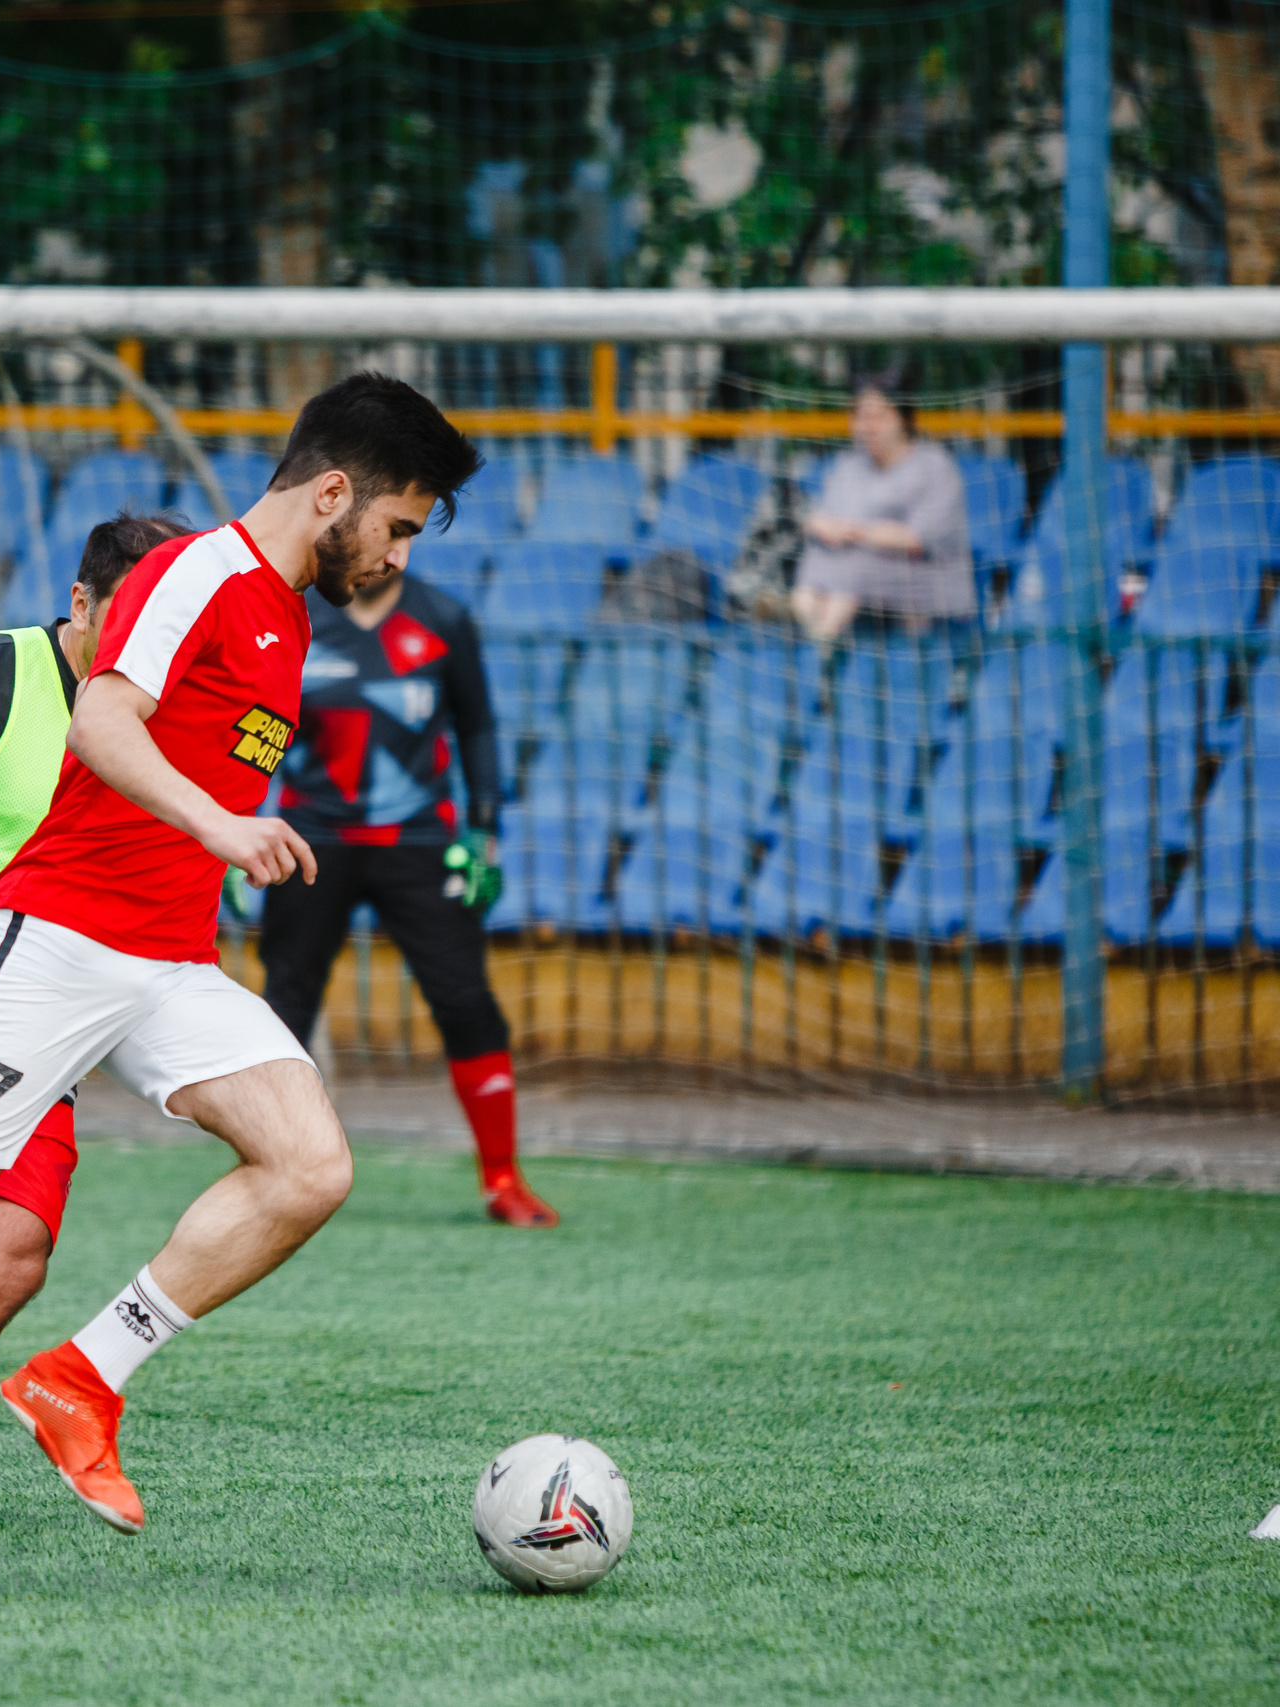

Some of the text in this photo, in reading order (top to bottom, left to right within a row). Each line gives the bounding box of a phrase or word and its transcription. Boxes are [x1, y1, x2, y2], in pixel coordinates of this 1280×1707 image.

[236, 708, 291, 750] PARI
[233, 732, 285, 774] MAT
[26, 1380, 76, 1416] NEMESIS
